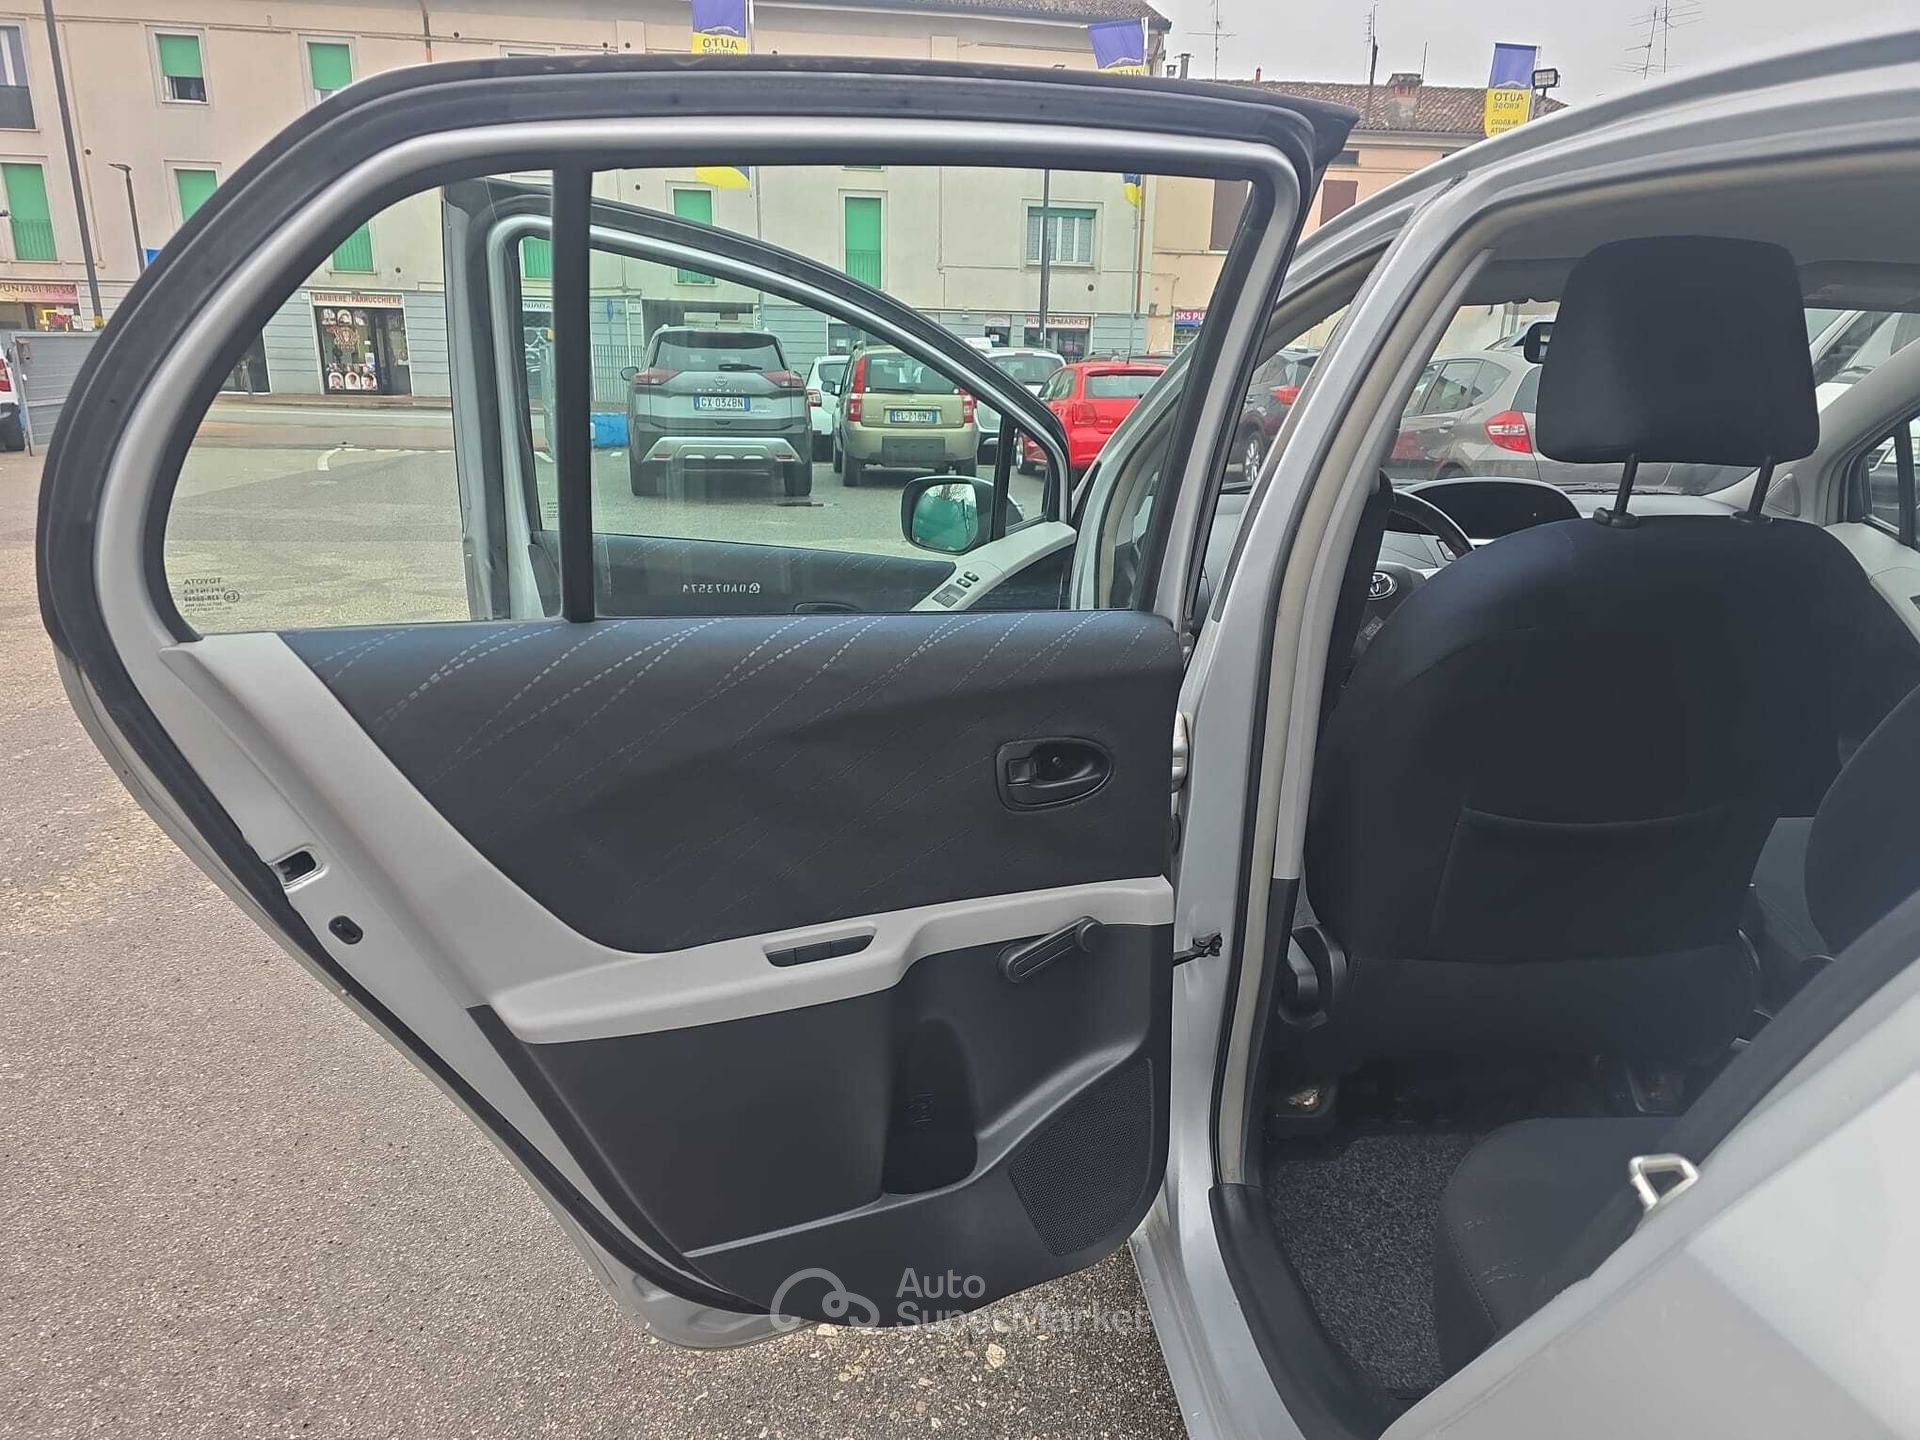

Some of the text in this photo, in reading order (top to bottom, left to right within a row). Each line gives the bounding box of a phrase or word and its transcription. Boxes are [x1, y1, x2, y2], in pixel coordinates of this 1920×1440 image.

[315, 294, 401, 305] BARBIERE PARRUCCHIERE
[1175, 311, 1191, 320] SKS
[1058, 318, 1089, 326] MARKET
